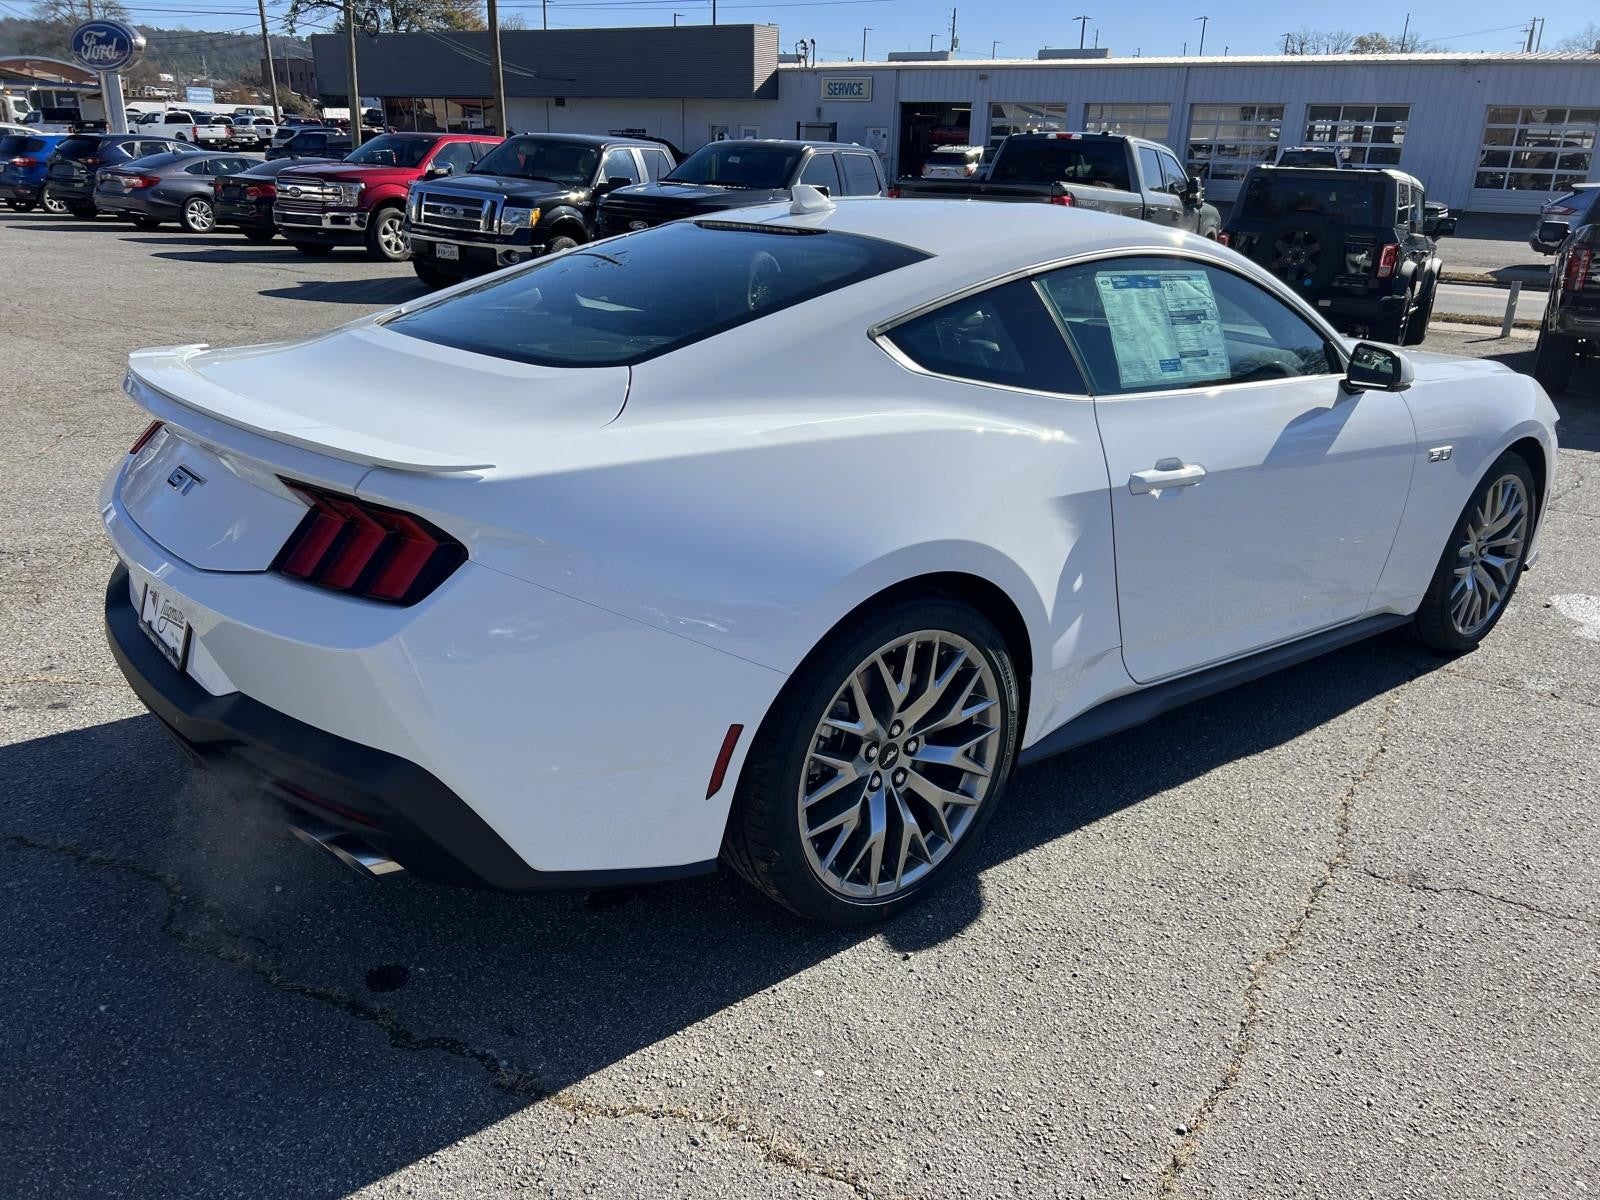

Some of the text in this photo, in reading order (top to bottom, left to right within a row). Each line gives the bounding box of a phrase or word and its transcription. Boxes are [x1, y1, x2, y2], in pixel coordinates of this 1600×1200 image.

[81, 30, 119, 60] Ford
[827, 82, 864, 96] SERVICE
[167, 464, 206, 496] GT
